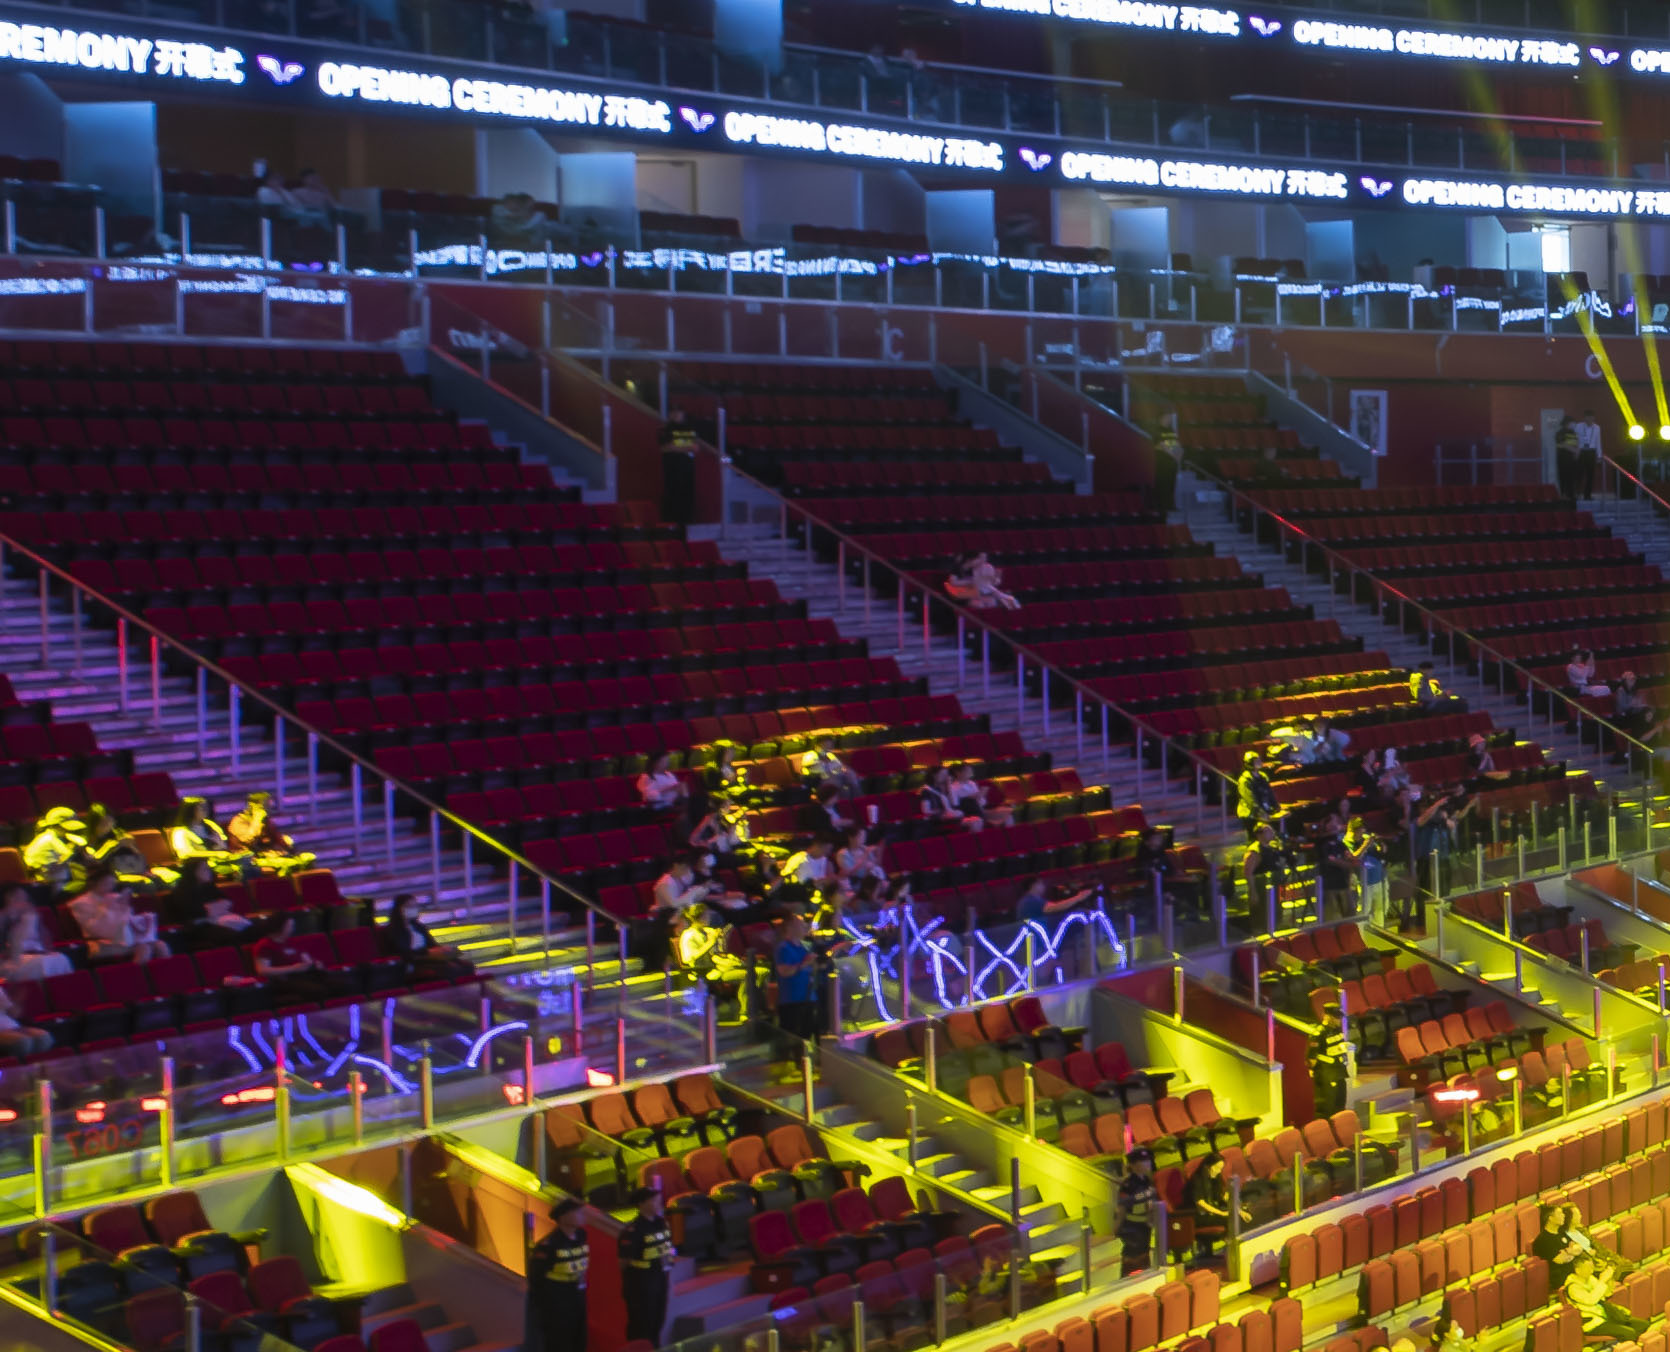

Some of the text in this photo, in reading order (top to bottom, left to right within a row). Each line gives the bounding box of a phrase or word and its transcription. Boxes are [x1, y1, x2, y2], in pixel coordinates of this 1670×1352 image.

[1293, 20, 1520, 62] OPENING CEREMONY
[318, 62, 603, 125] OPENING CEREMONY
[724, 111, 945, 165] OPENING CEREMONY
[1403, 179, 1634, 214] OPENING CEREMONY
